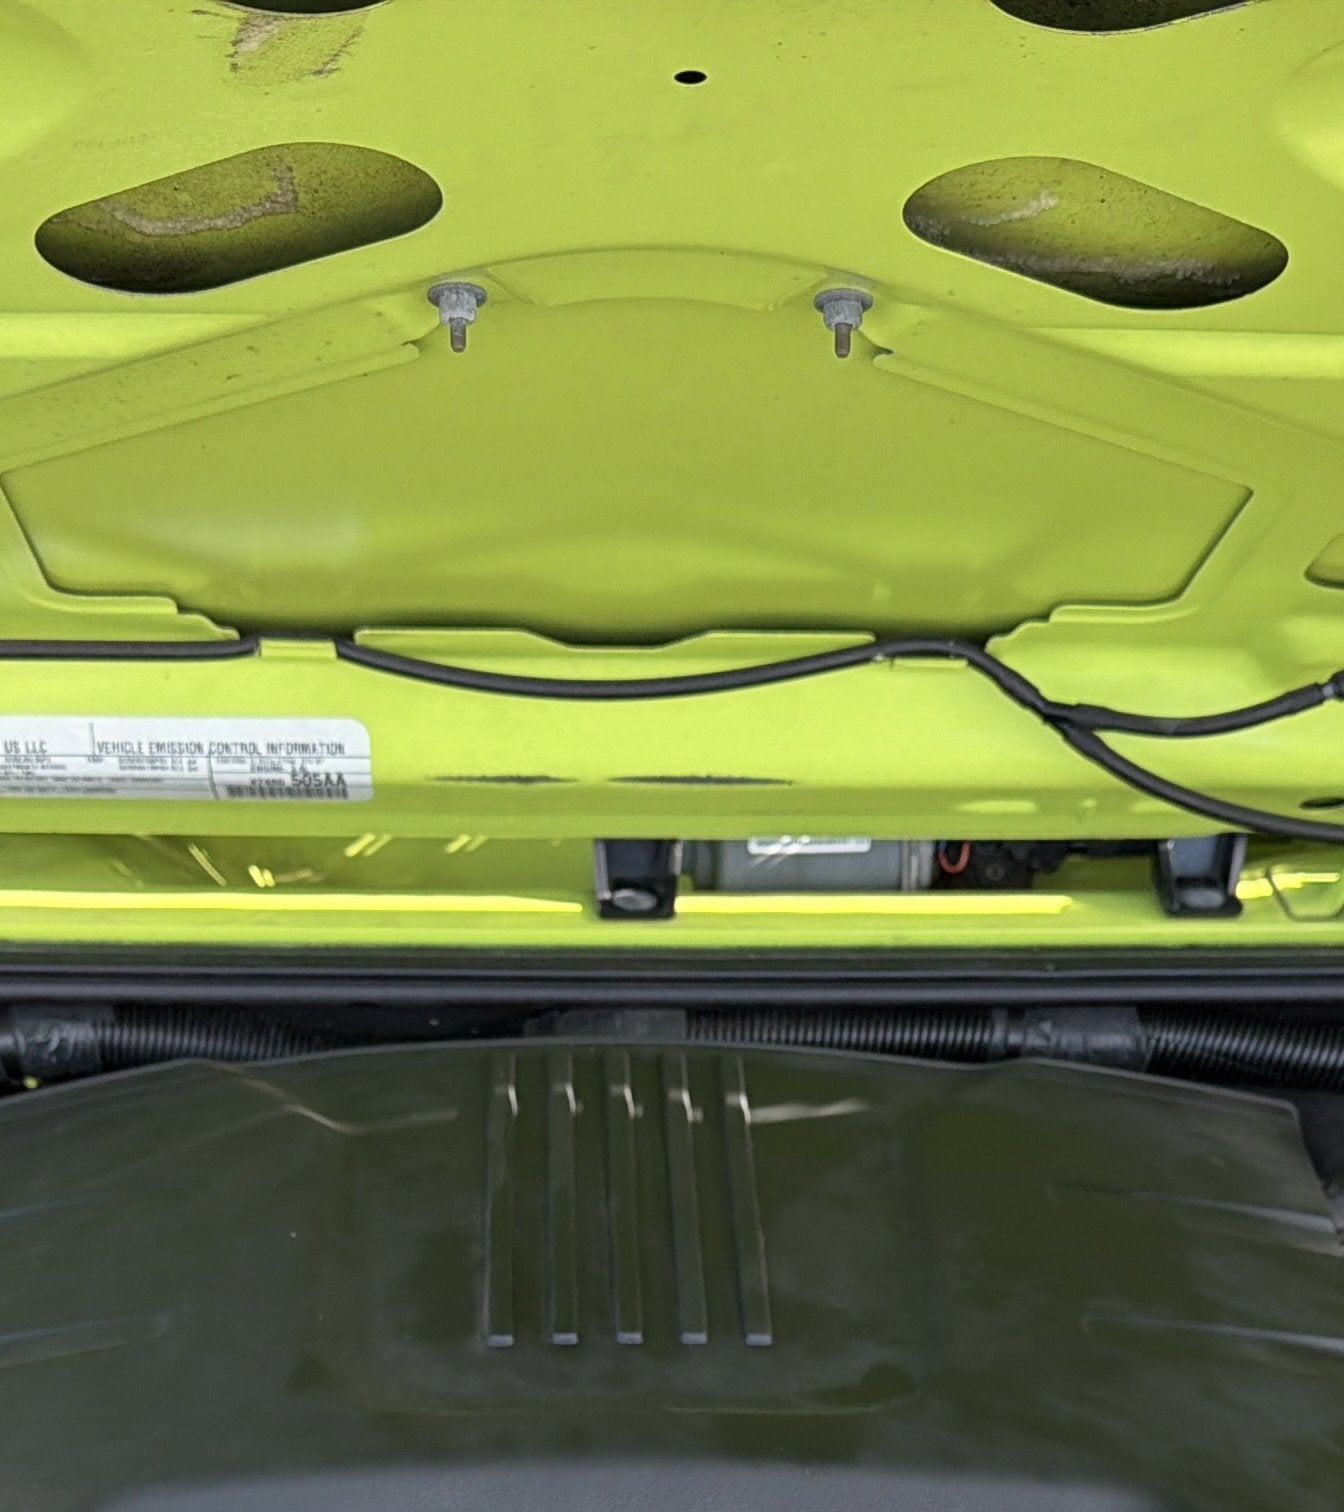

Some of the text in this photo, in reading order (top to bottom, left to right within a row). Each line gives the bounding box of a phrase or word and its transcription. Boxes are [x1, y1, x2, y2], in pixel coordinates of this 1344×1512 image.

[4, 740, 20, 754] US
[24, 740, 47, 754] LLC
[96, 740, 346, 756] VEHICLE EMISSION CONTROL INFORMATION
